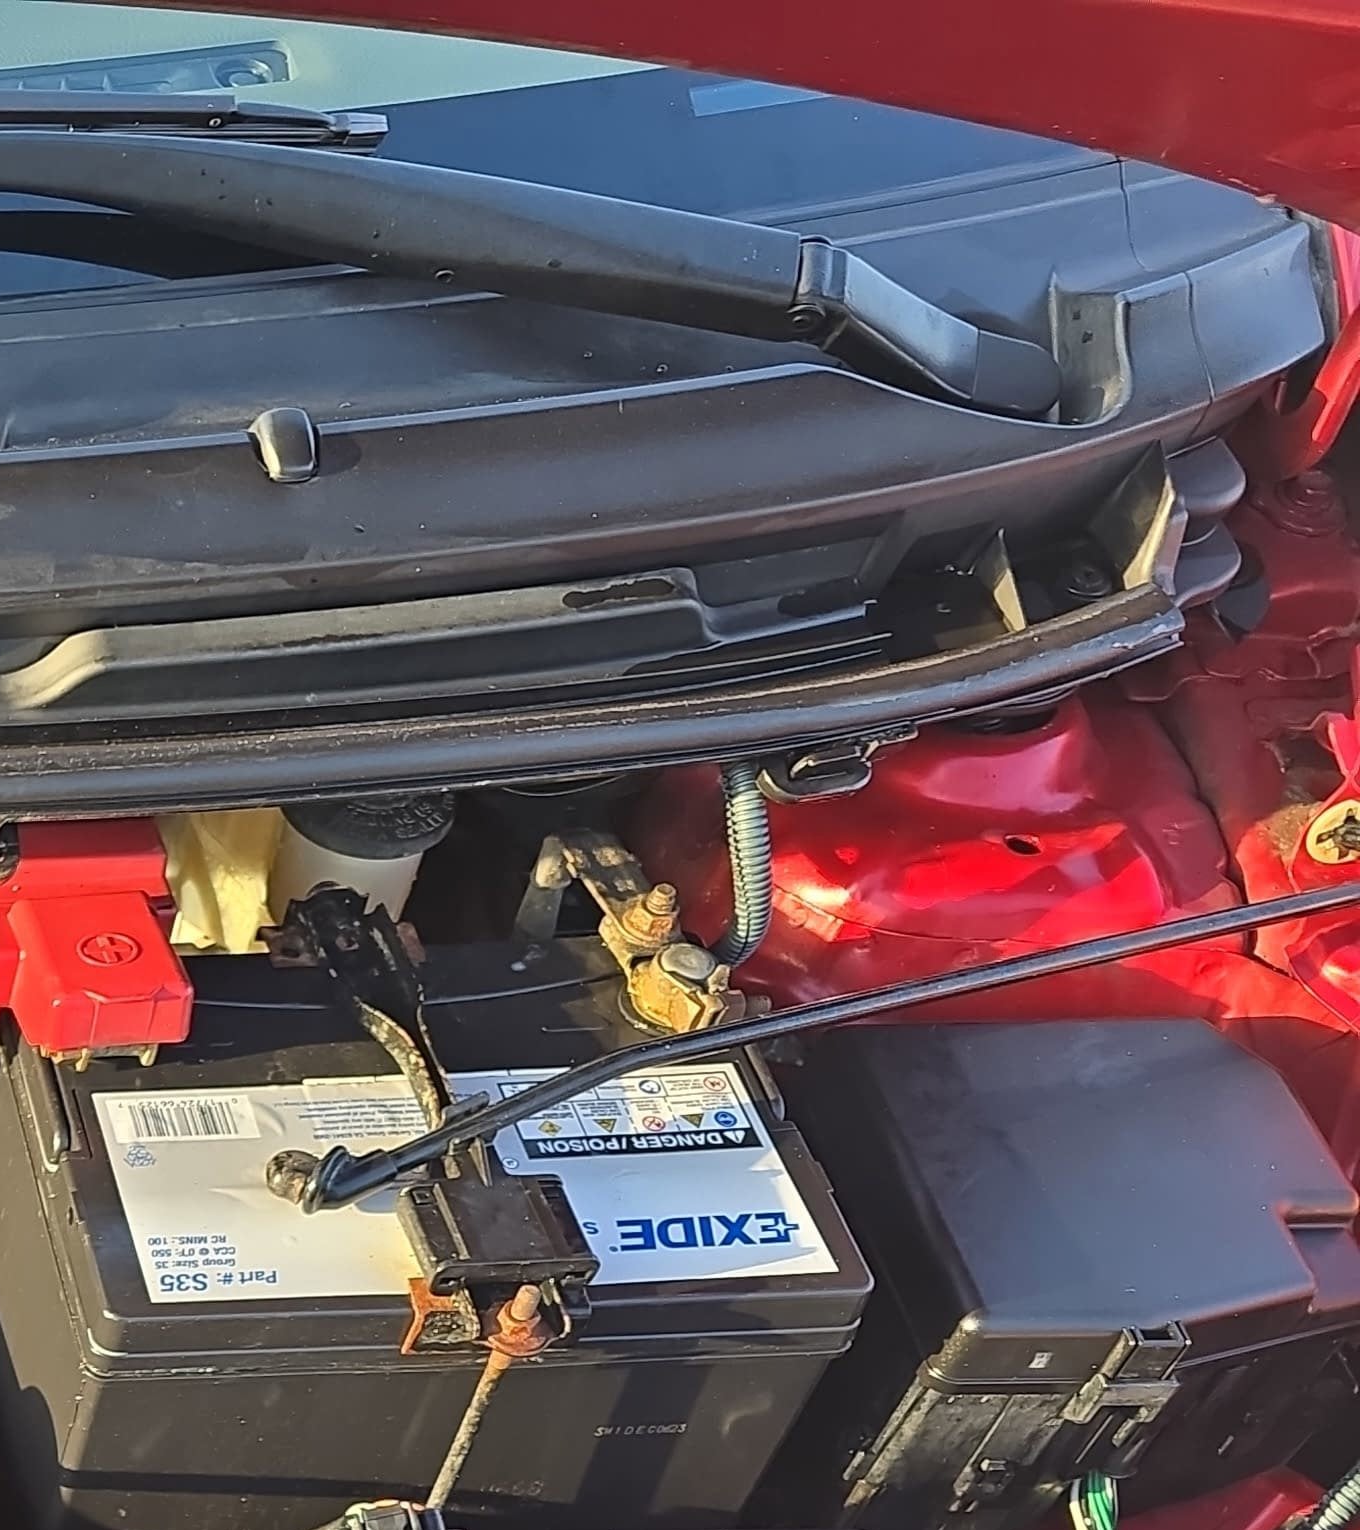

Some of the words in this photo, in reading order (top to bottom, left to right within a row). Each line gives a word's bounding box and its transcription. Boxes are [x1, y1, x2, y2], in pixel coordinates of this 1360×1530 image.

[536, 1138, 621, 1155] POISON
[632, 1132, 724, 1150] DANGER
[615, 1211, 800, 1252] EXIDE
[211, 1235, 226, 1244] RC
[213, 1247, 236, 1256] CCA
[155, 1260, 169, 1270] 35
[172, 1259, 199, 1268] Size:
[202, 1258, 236, 1268] Group
[160, 1272, 208, 1293] S35
[239, 1270, 277, 1285] Part
